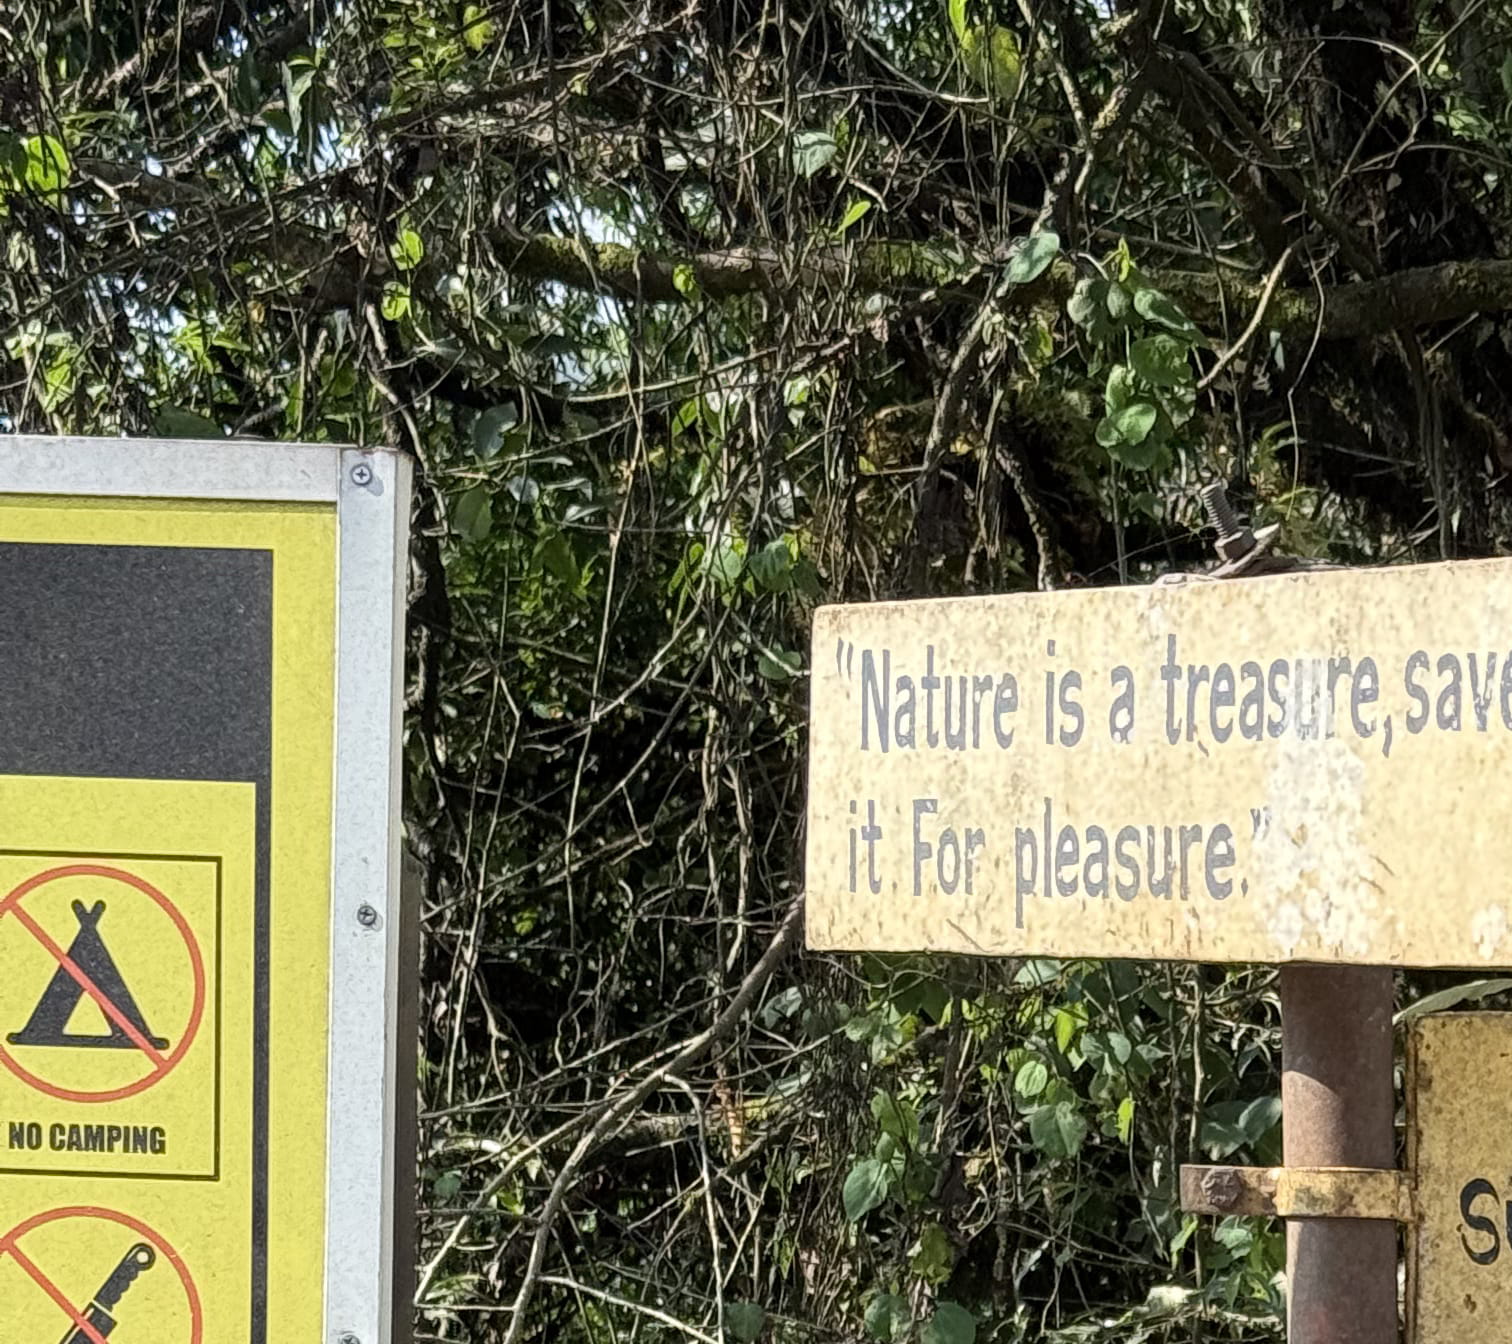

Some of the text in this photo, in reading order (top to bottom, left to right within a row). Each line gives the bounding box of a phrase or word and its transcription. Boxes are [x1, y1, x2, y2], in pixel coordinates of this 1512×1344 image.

[1045, 640, 1084, 747] is
[1109, 664, 1136, 744] a
[848, 801, 883, 894] it
[912, 798, 986, 897] For
[8, 1121, 167, 1155] NO CAMPING
